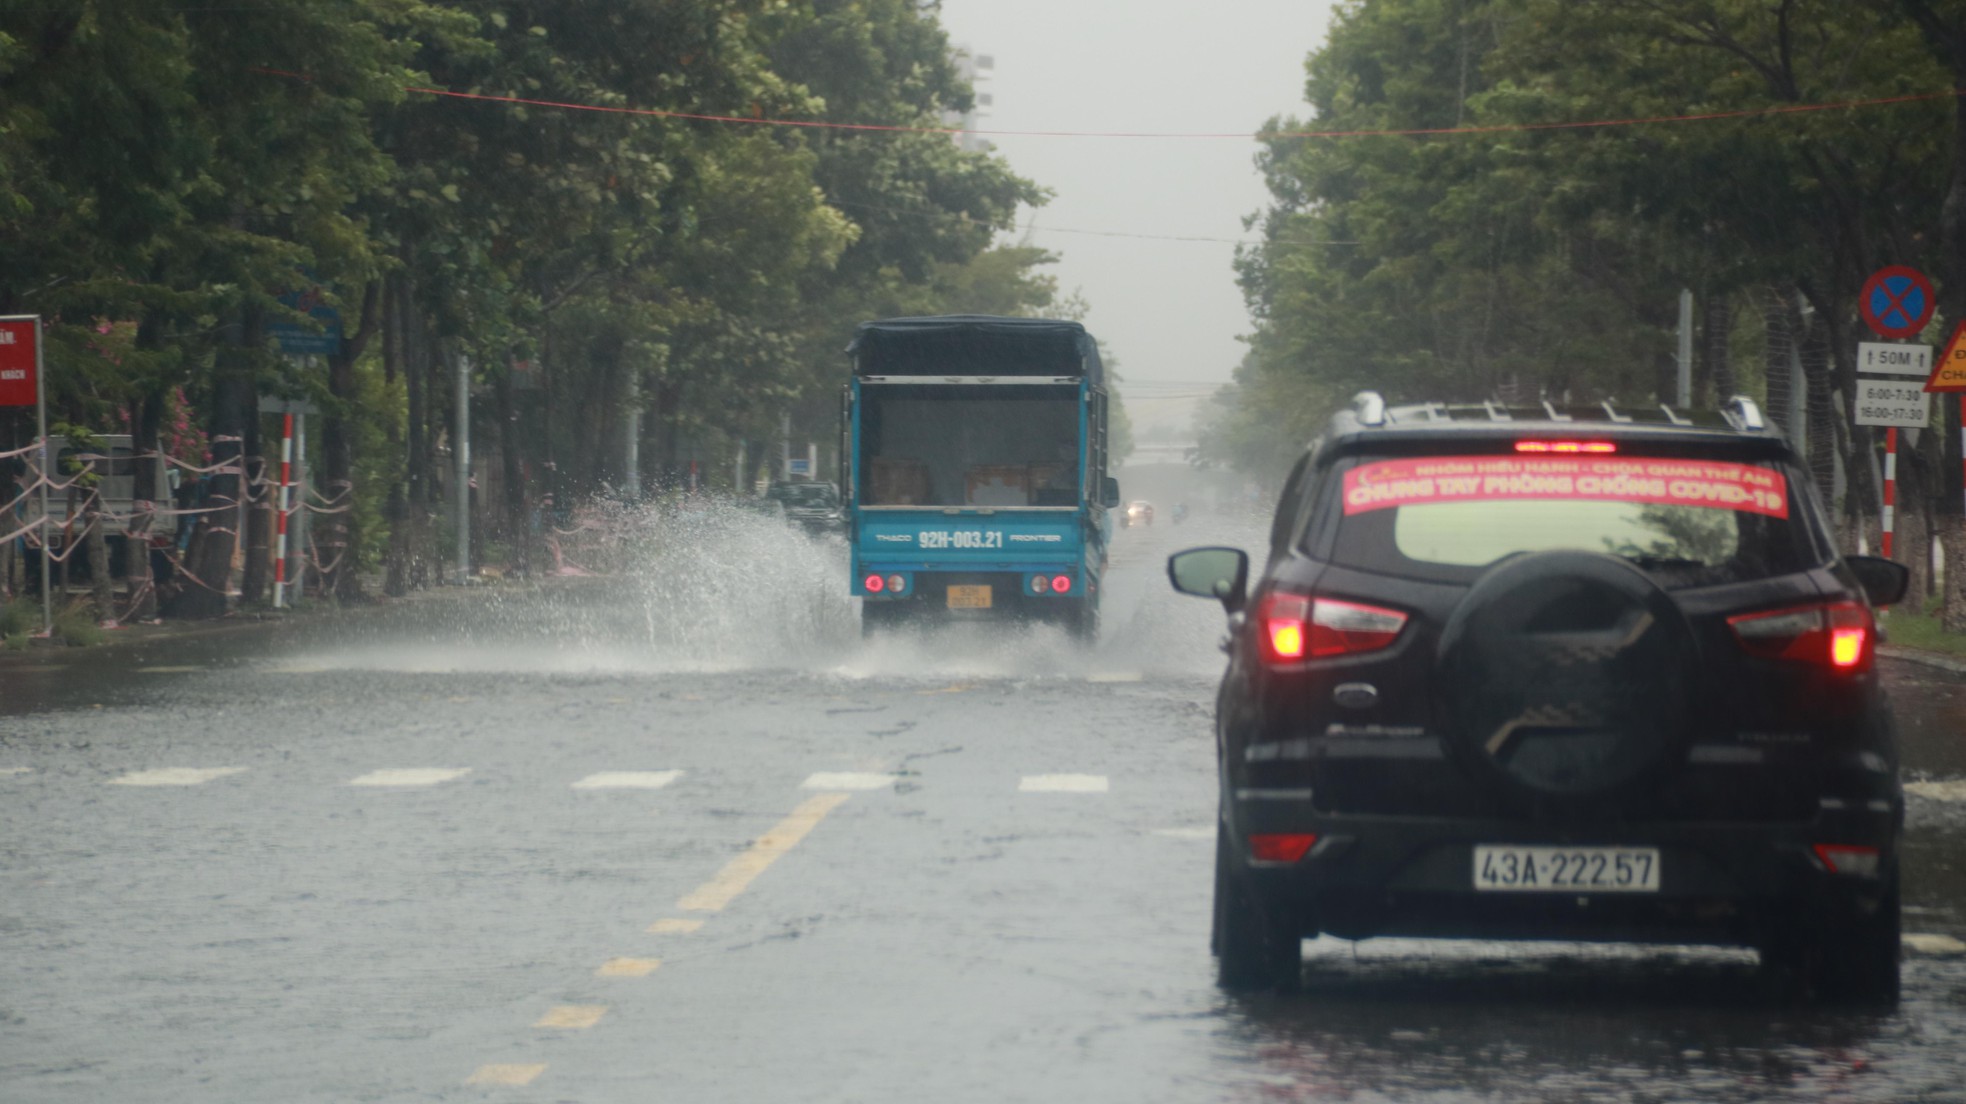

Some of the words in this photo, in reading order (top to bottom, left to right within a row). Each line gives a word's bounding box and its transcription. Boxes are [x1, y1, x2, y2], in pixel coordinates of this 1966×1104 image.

[1879, 351, 1911, 365] 50M
[1866, 388, 1921, 401] 6:00-7:30
[1861, 406, 1924, 420] 16:00-17:30
[1647, 464, 1702, 478] QUAN
[1348, 478, 1434, 505] CHUNG
[1436, 476, 1481, 496] TAY
[1484, 473, 1573, 494] PHÒNG
[1575, 473, 1667, 497] CHỐNG
[1668, 480, 1783, 510] COVID-19
[919, 531, 1003, 548] 92H-003.21
[1009, 534, 1062, 542] FRONTIER
